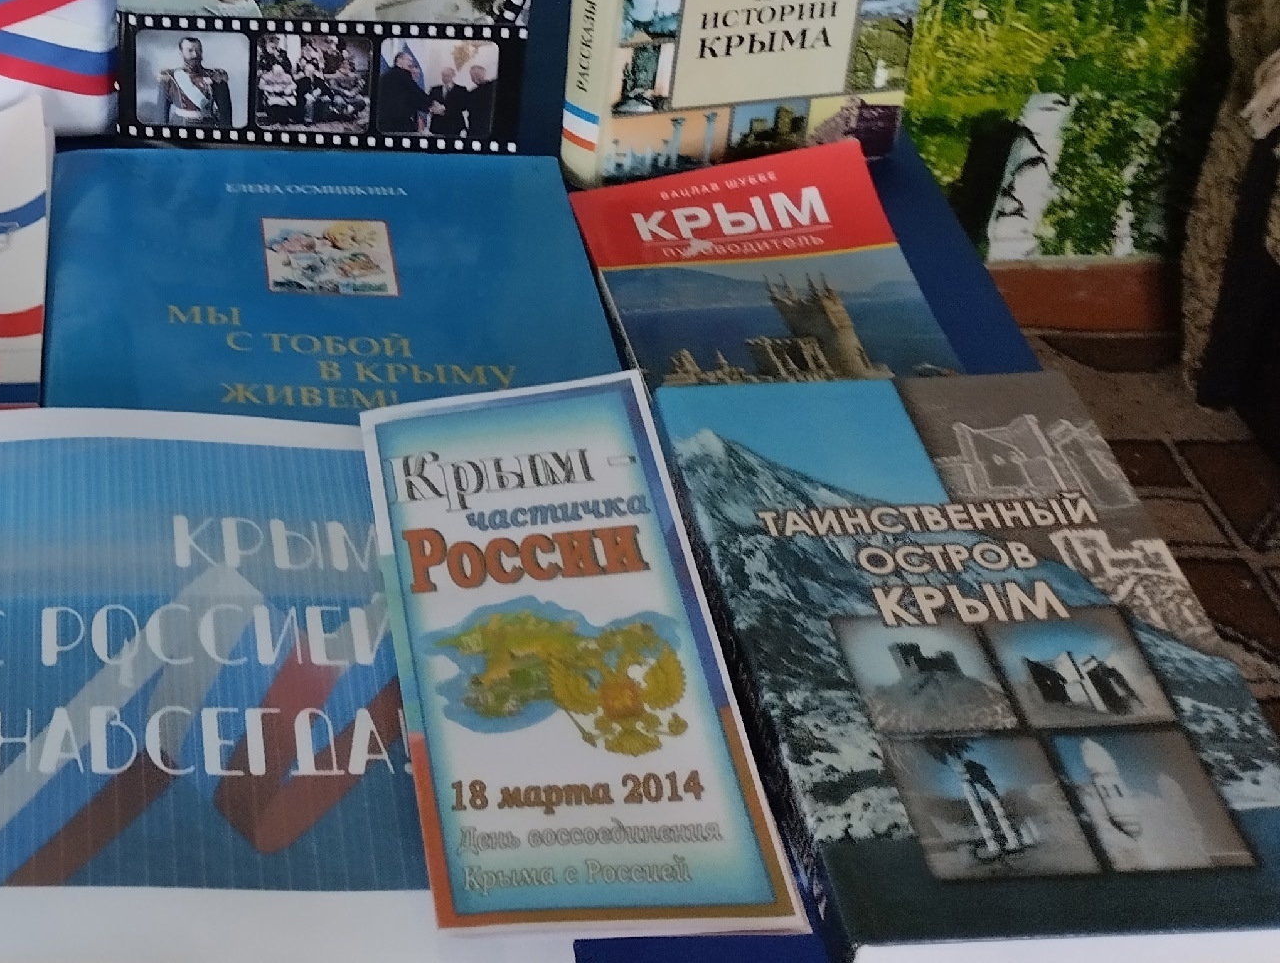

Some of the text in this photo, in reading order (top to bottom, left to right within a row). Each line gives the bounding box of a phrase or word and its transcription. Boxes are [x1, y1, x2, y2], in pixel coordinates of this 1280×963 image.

[700, 1, 839, 30] ИСТОРИИ
[697, 27, 832, 60] КРЫМА
[660, 182, 720, 201] ВАЦЛАВ
[631, 185, 832, 241] КРЫМ
[167, 304, 241, 326] МЫ
[227, 332, 413, 359] С ТОБОЙ
[320, 360, 517, 390] В КРЫМУ
[389, 448, 596, 513] Крым
[465, 493, 651, 532] частичка
[758, 489, 1099, 538] ТАИНСТВЕННЫЙ
[174, 515, 380, 573] КРЫМ
[858, 541, 1038, 576] ОСТРОВ
[872, 580, 1070, 628] КРЫМ
[451, 770, 705, 815] 18 марта 2014
[458, 816, 723, 854] День воссоединения
[463, 853, 692, 897] Крыма с Россией
